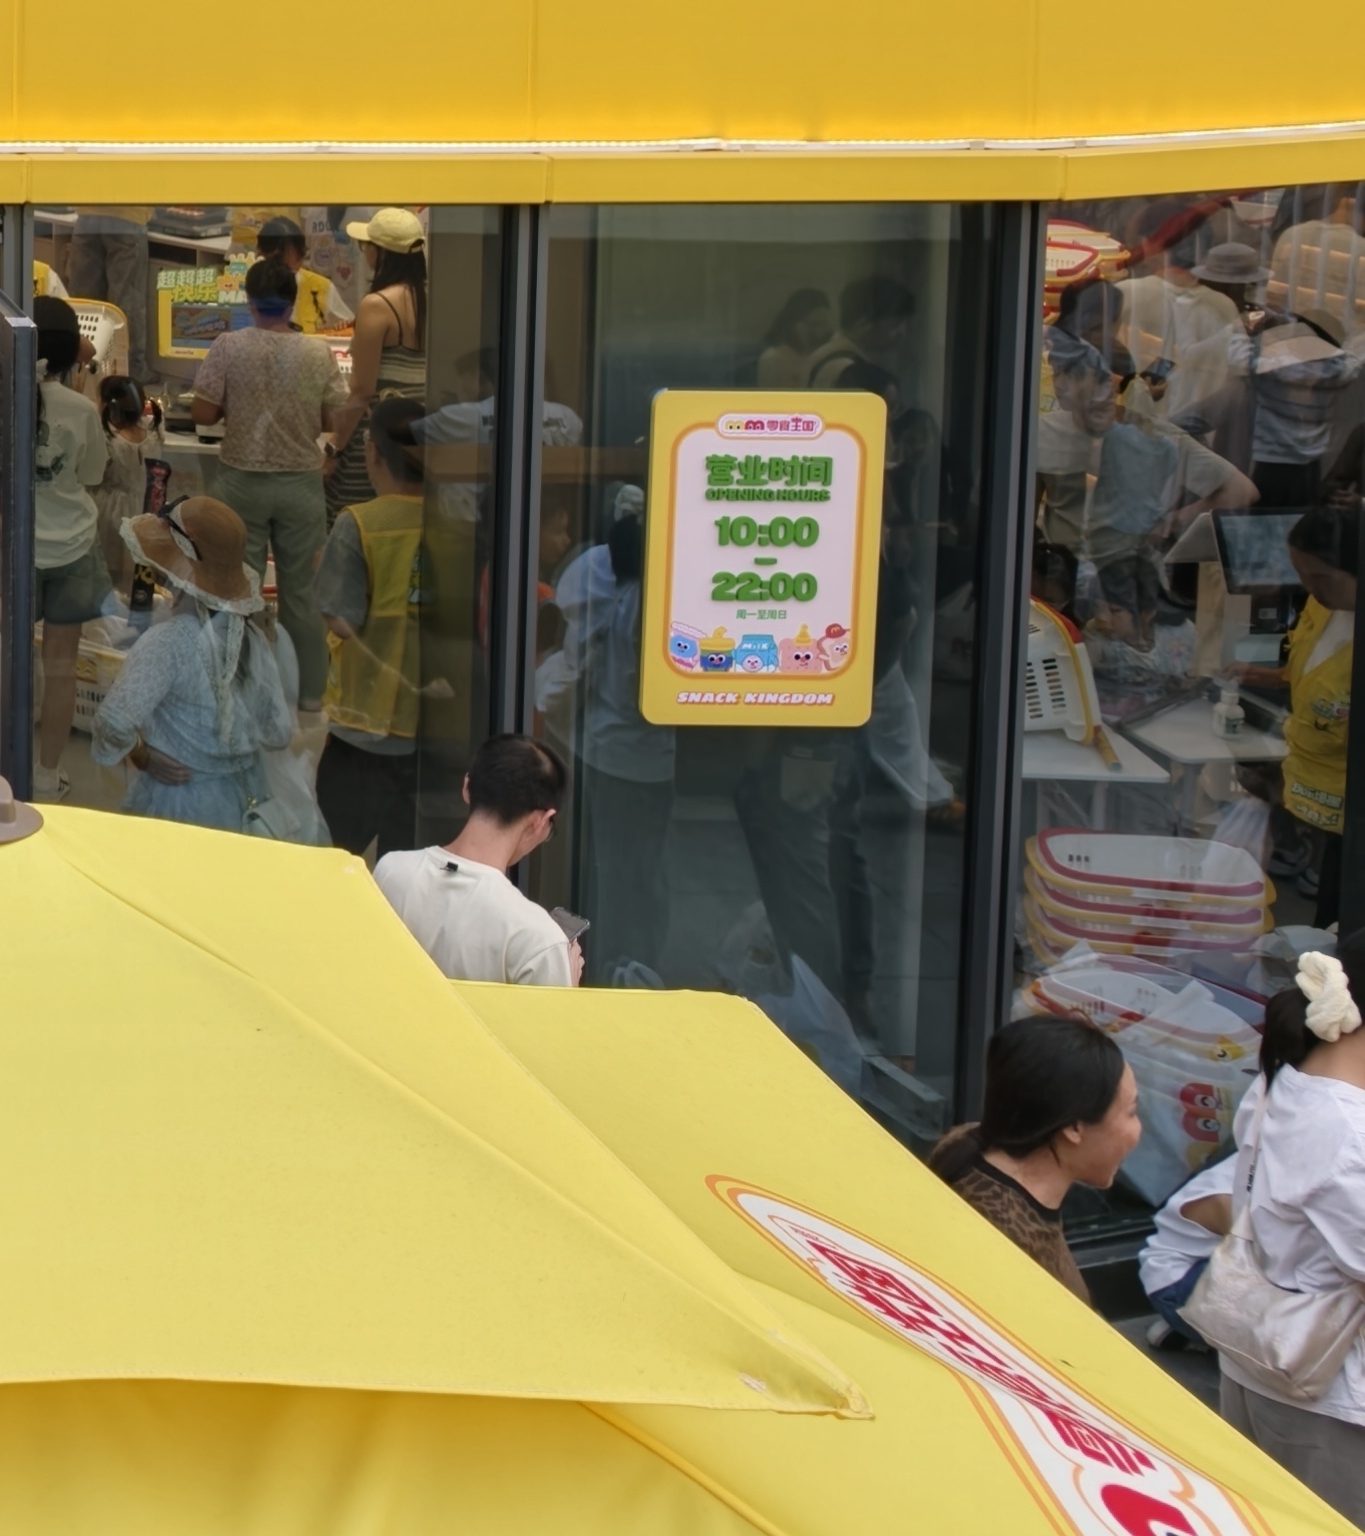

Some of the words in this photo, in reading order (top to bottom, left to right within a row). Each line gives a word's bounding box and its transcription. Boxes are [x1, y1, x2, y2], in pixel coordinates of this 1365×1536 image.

[156, 267, 216, 290] 超超超
[705, 454, 833, 487] 营业时间
[705, 488, 775, 502] OPENING
[777, 488, 831, 502] HOURS
[714, 516, 819, 547] 10:00
[711, 571, 818, 602] 22:00
[736, 609, 787, 620] 周一至周日
[677, 692, 740, 705] SNACK
[744, 693, 836, 706] KINGDOM
